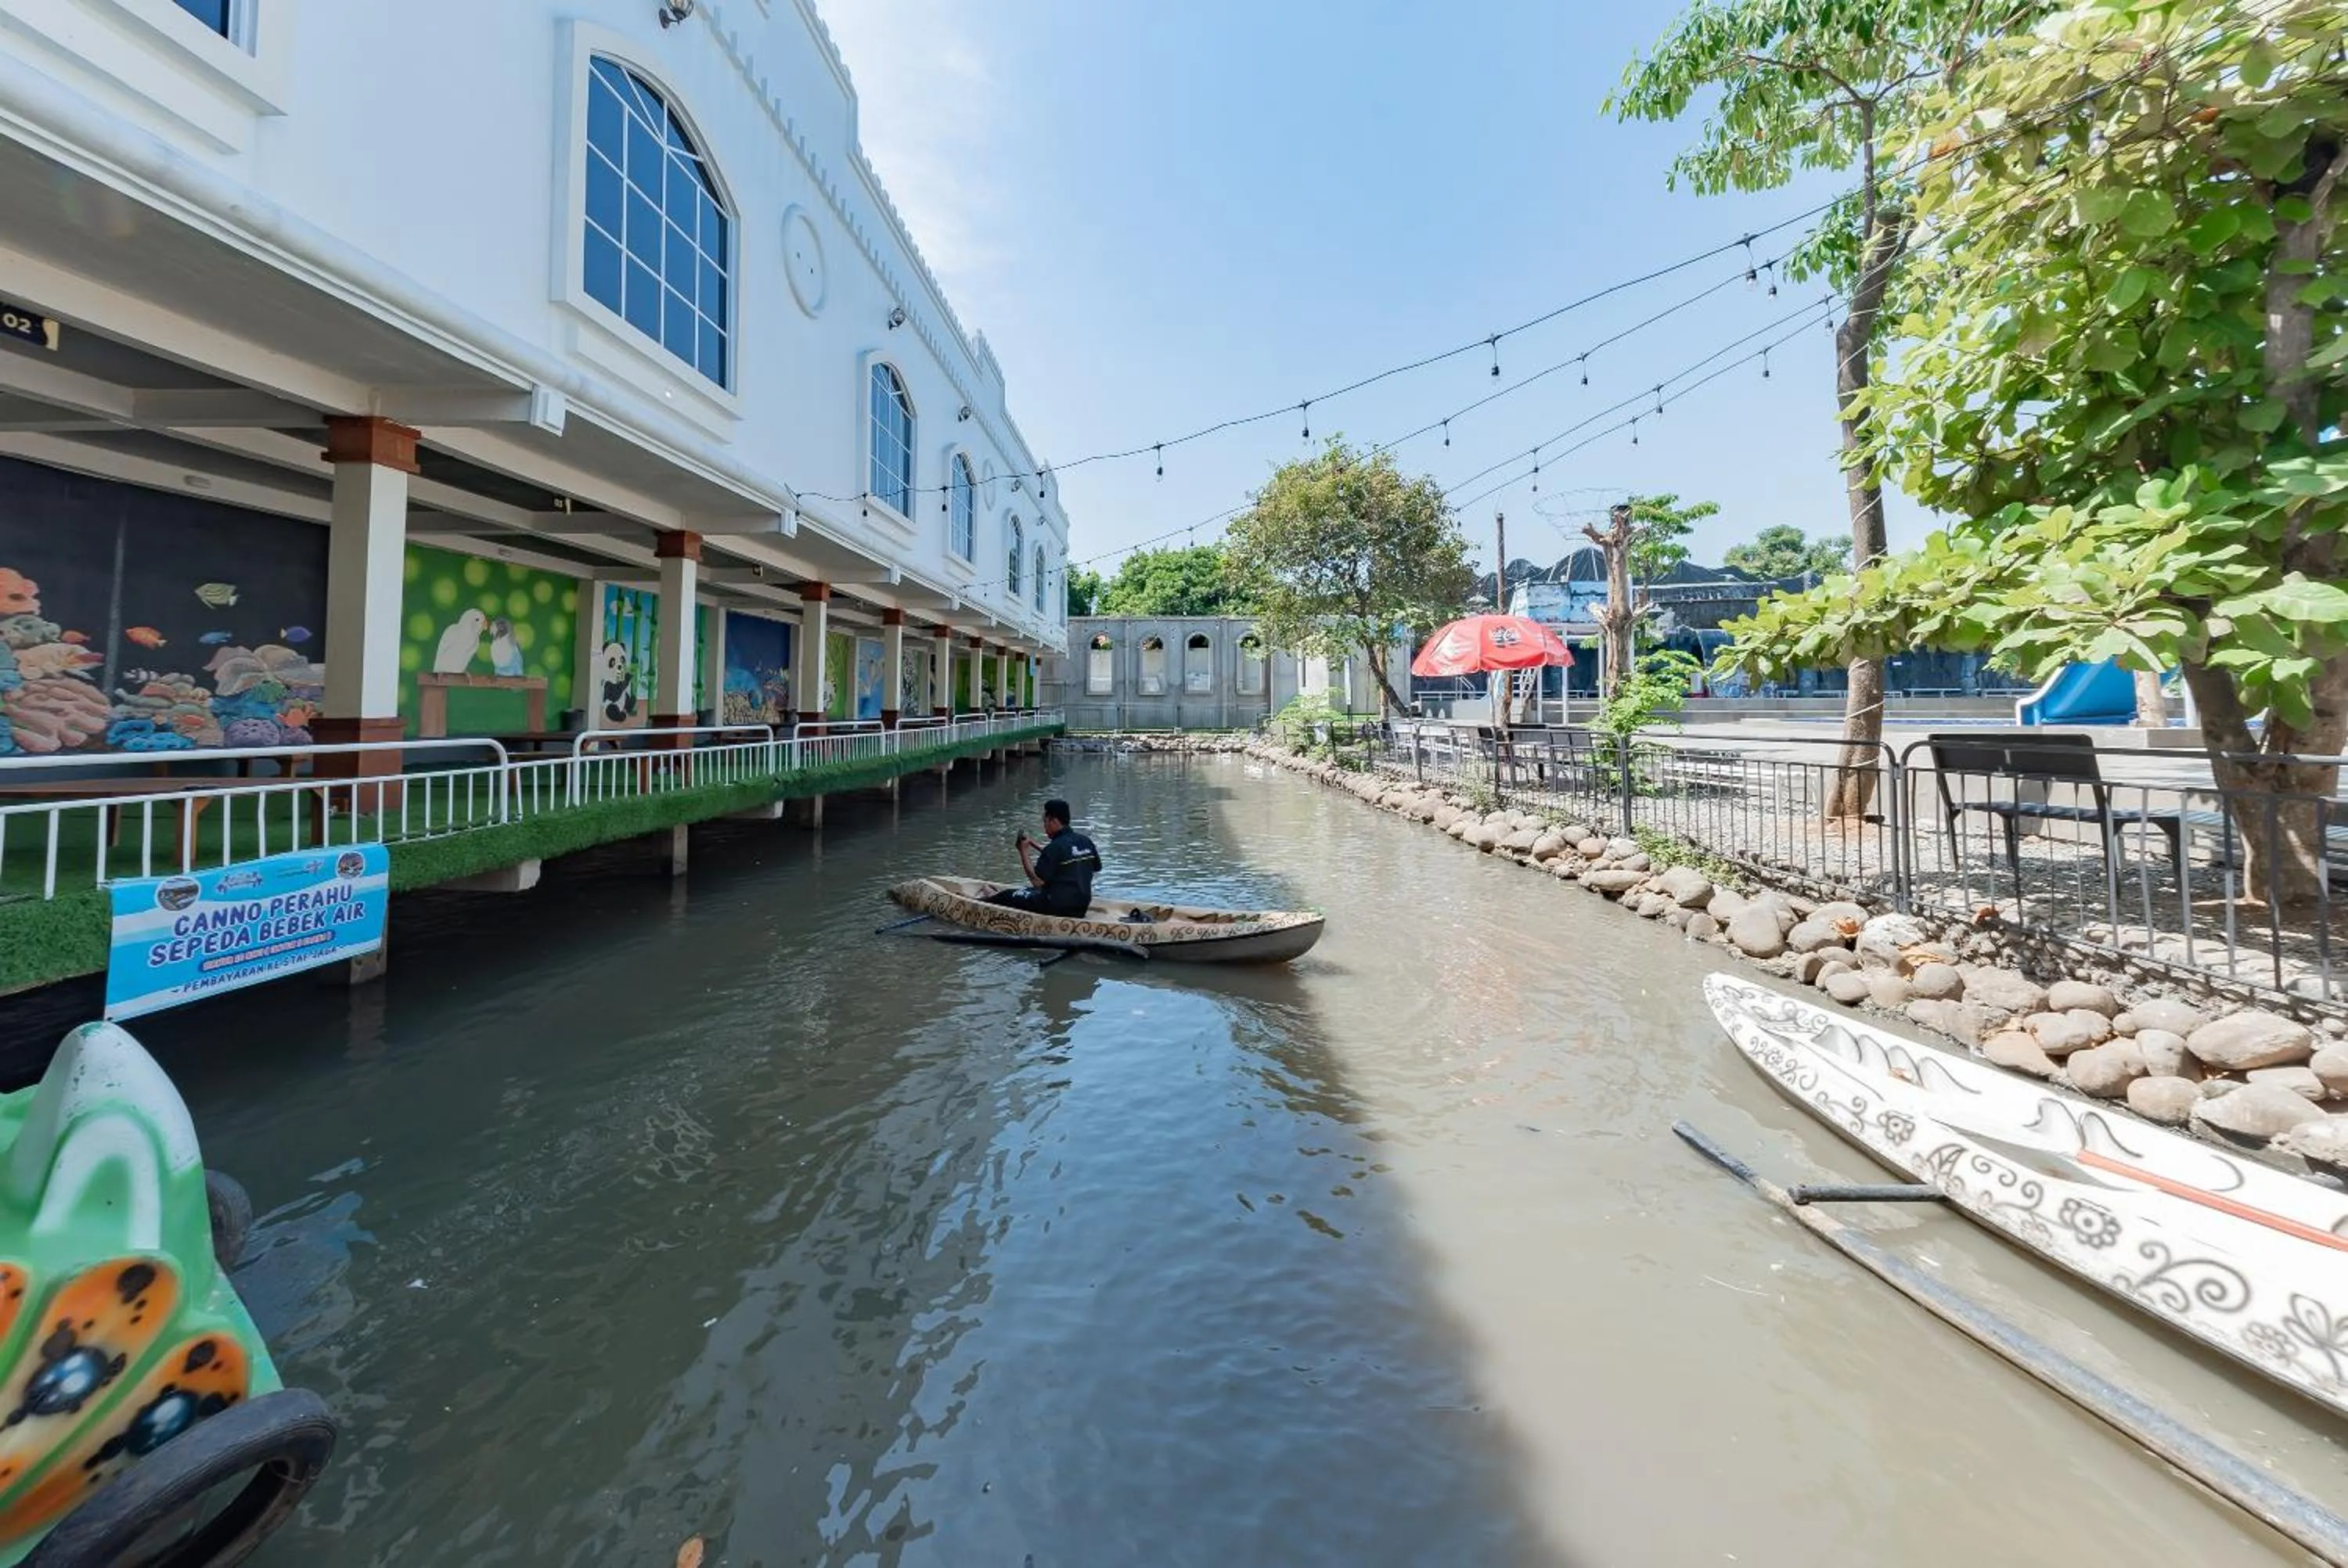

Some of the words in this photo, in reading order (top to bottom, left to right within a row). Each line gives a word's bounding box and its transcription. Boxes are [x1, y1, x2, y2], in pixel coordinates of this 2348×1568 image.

[3, 313, 31, 334] 02
[175, 901, 262, 937] CANNO
[269, 884, 352, 919] PERAHU
[149, 925, 250, 967] SEPEDA
[259, 910, 326, 941] BEBEK
[333, 902, 366, 924] AIR
[183, 965, 265, 994] PEMBAYARAN
[267, 959, 280, 970] KE
